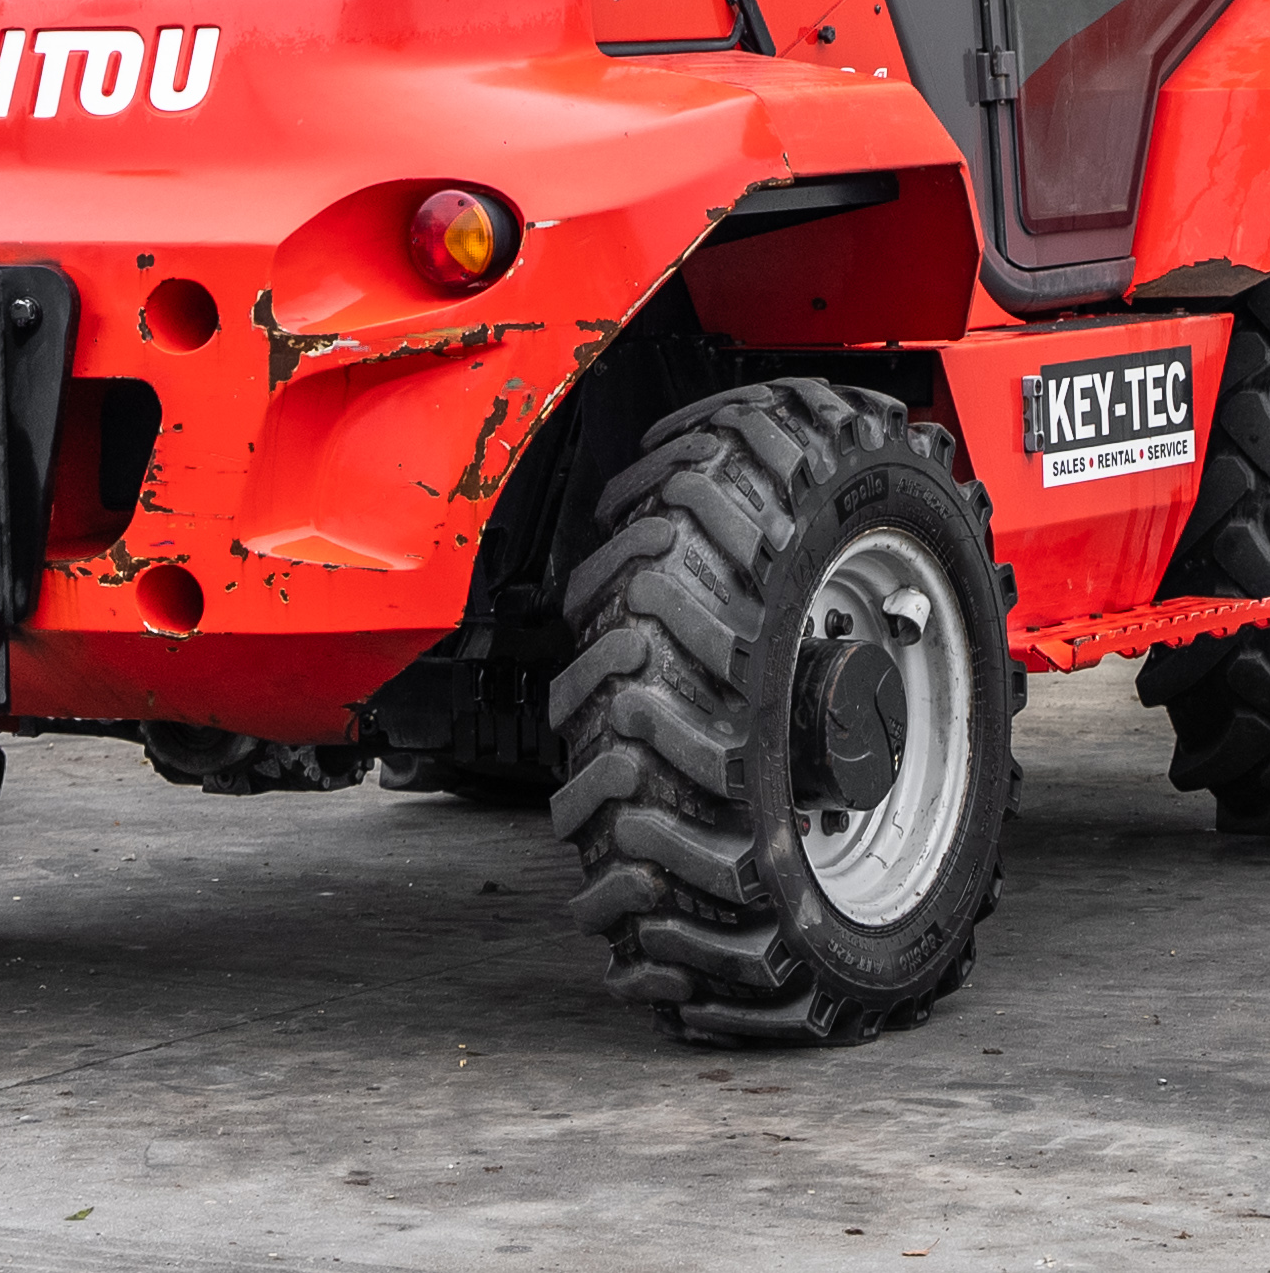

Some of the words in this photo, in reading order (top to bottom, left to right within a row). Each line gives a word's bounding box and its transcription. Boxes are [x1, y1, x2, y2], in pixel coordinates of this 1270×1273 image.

[1047, 360, 1188, 444] KEY-TEC
[1052, 456, 1086, 477] SALES
[1097, 448, 1137, 470] RENTAL
[1147, 439, 1188, 461] SERVICE
[843, 473, 884, 513] apollo
